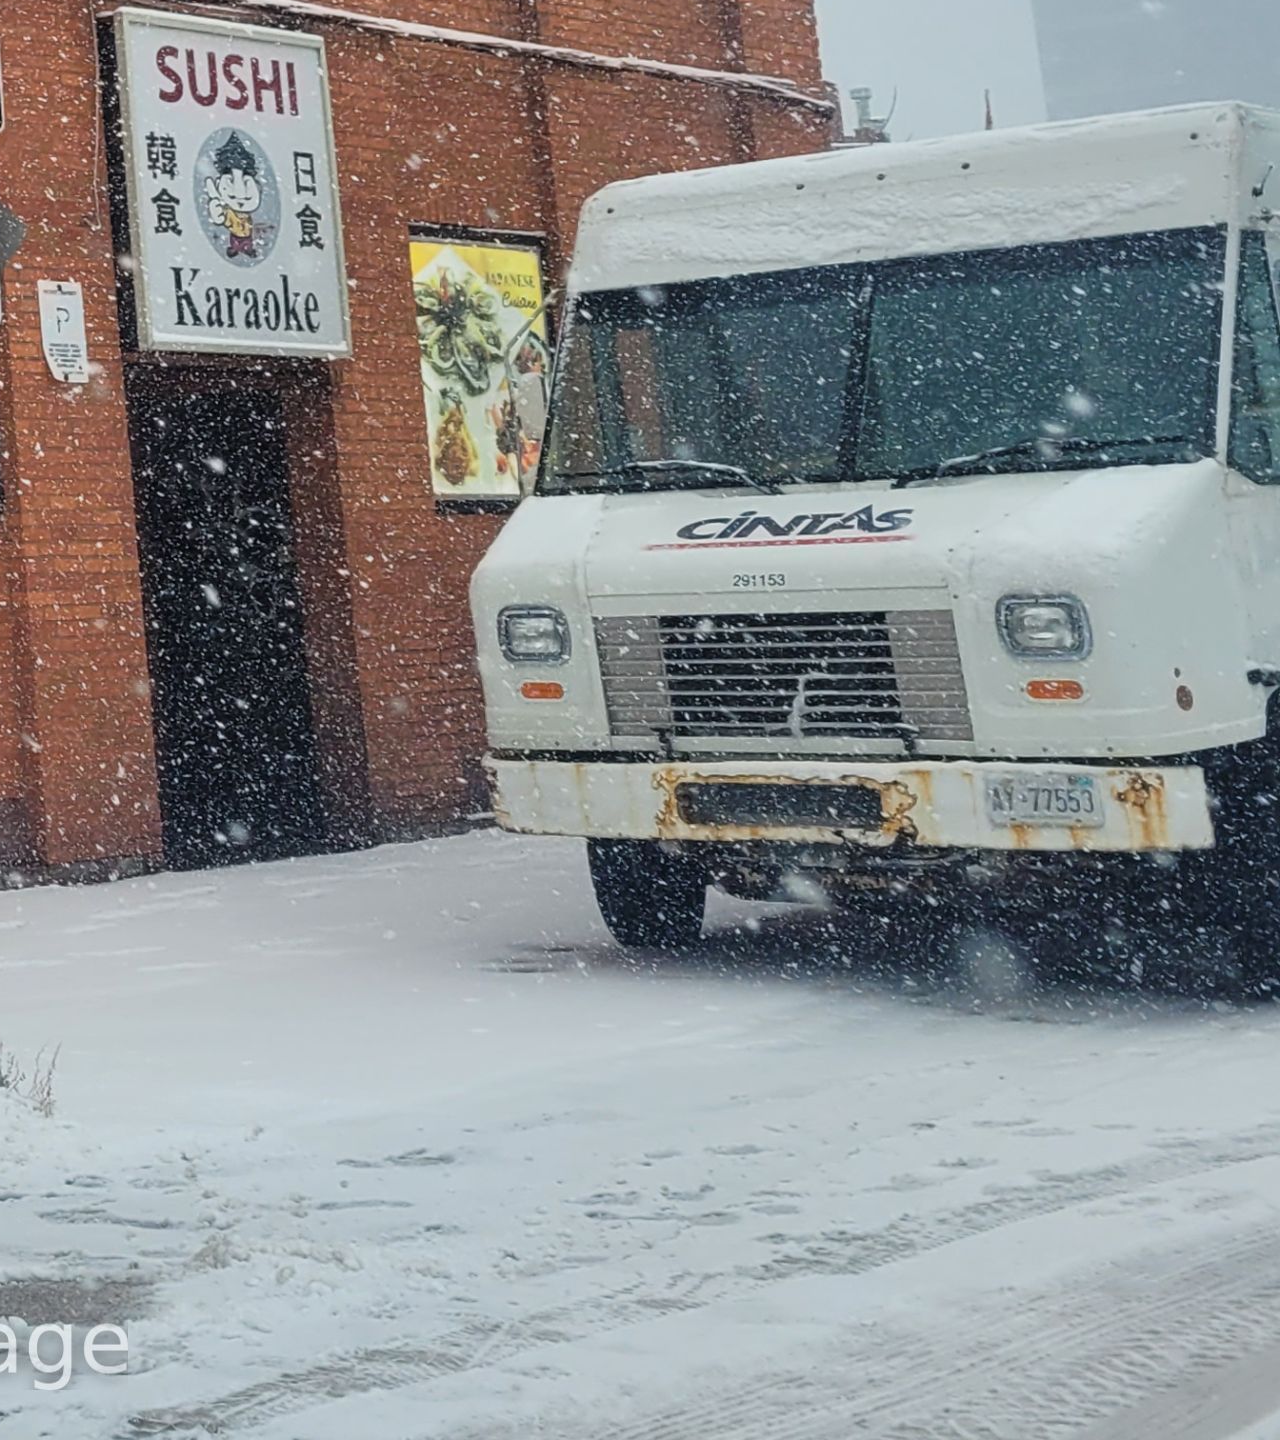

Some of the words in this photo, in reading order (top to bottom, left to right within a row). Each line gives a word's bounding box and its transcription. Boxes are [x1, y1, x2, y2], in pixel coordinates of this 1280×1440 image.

[155, 45, 299, 117] SUSHI
[485, 271, 536, 288] JAPANESE
[170, 266, 321, 334] Karaoke
[676, 504, 915, 540] CINTAS
[732, 574, 786, 588] 291153
